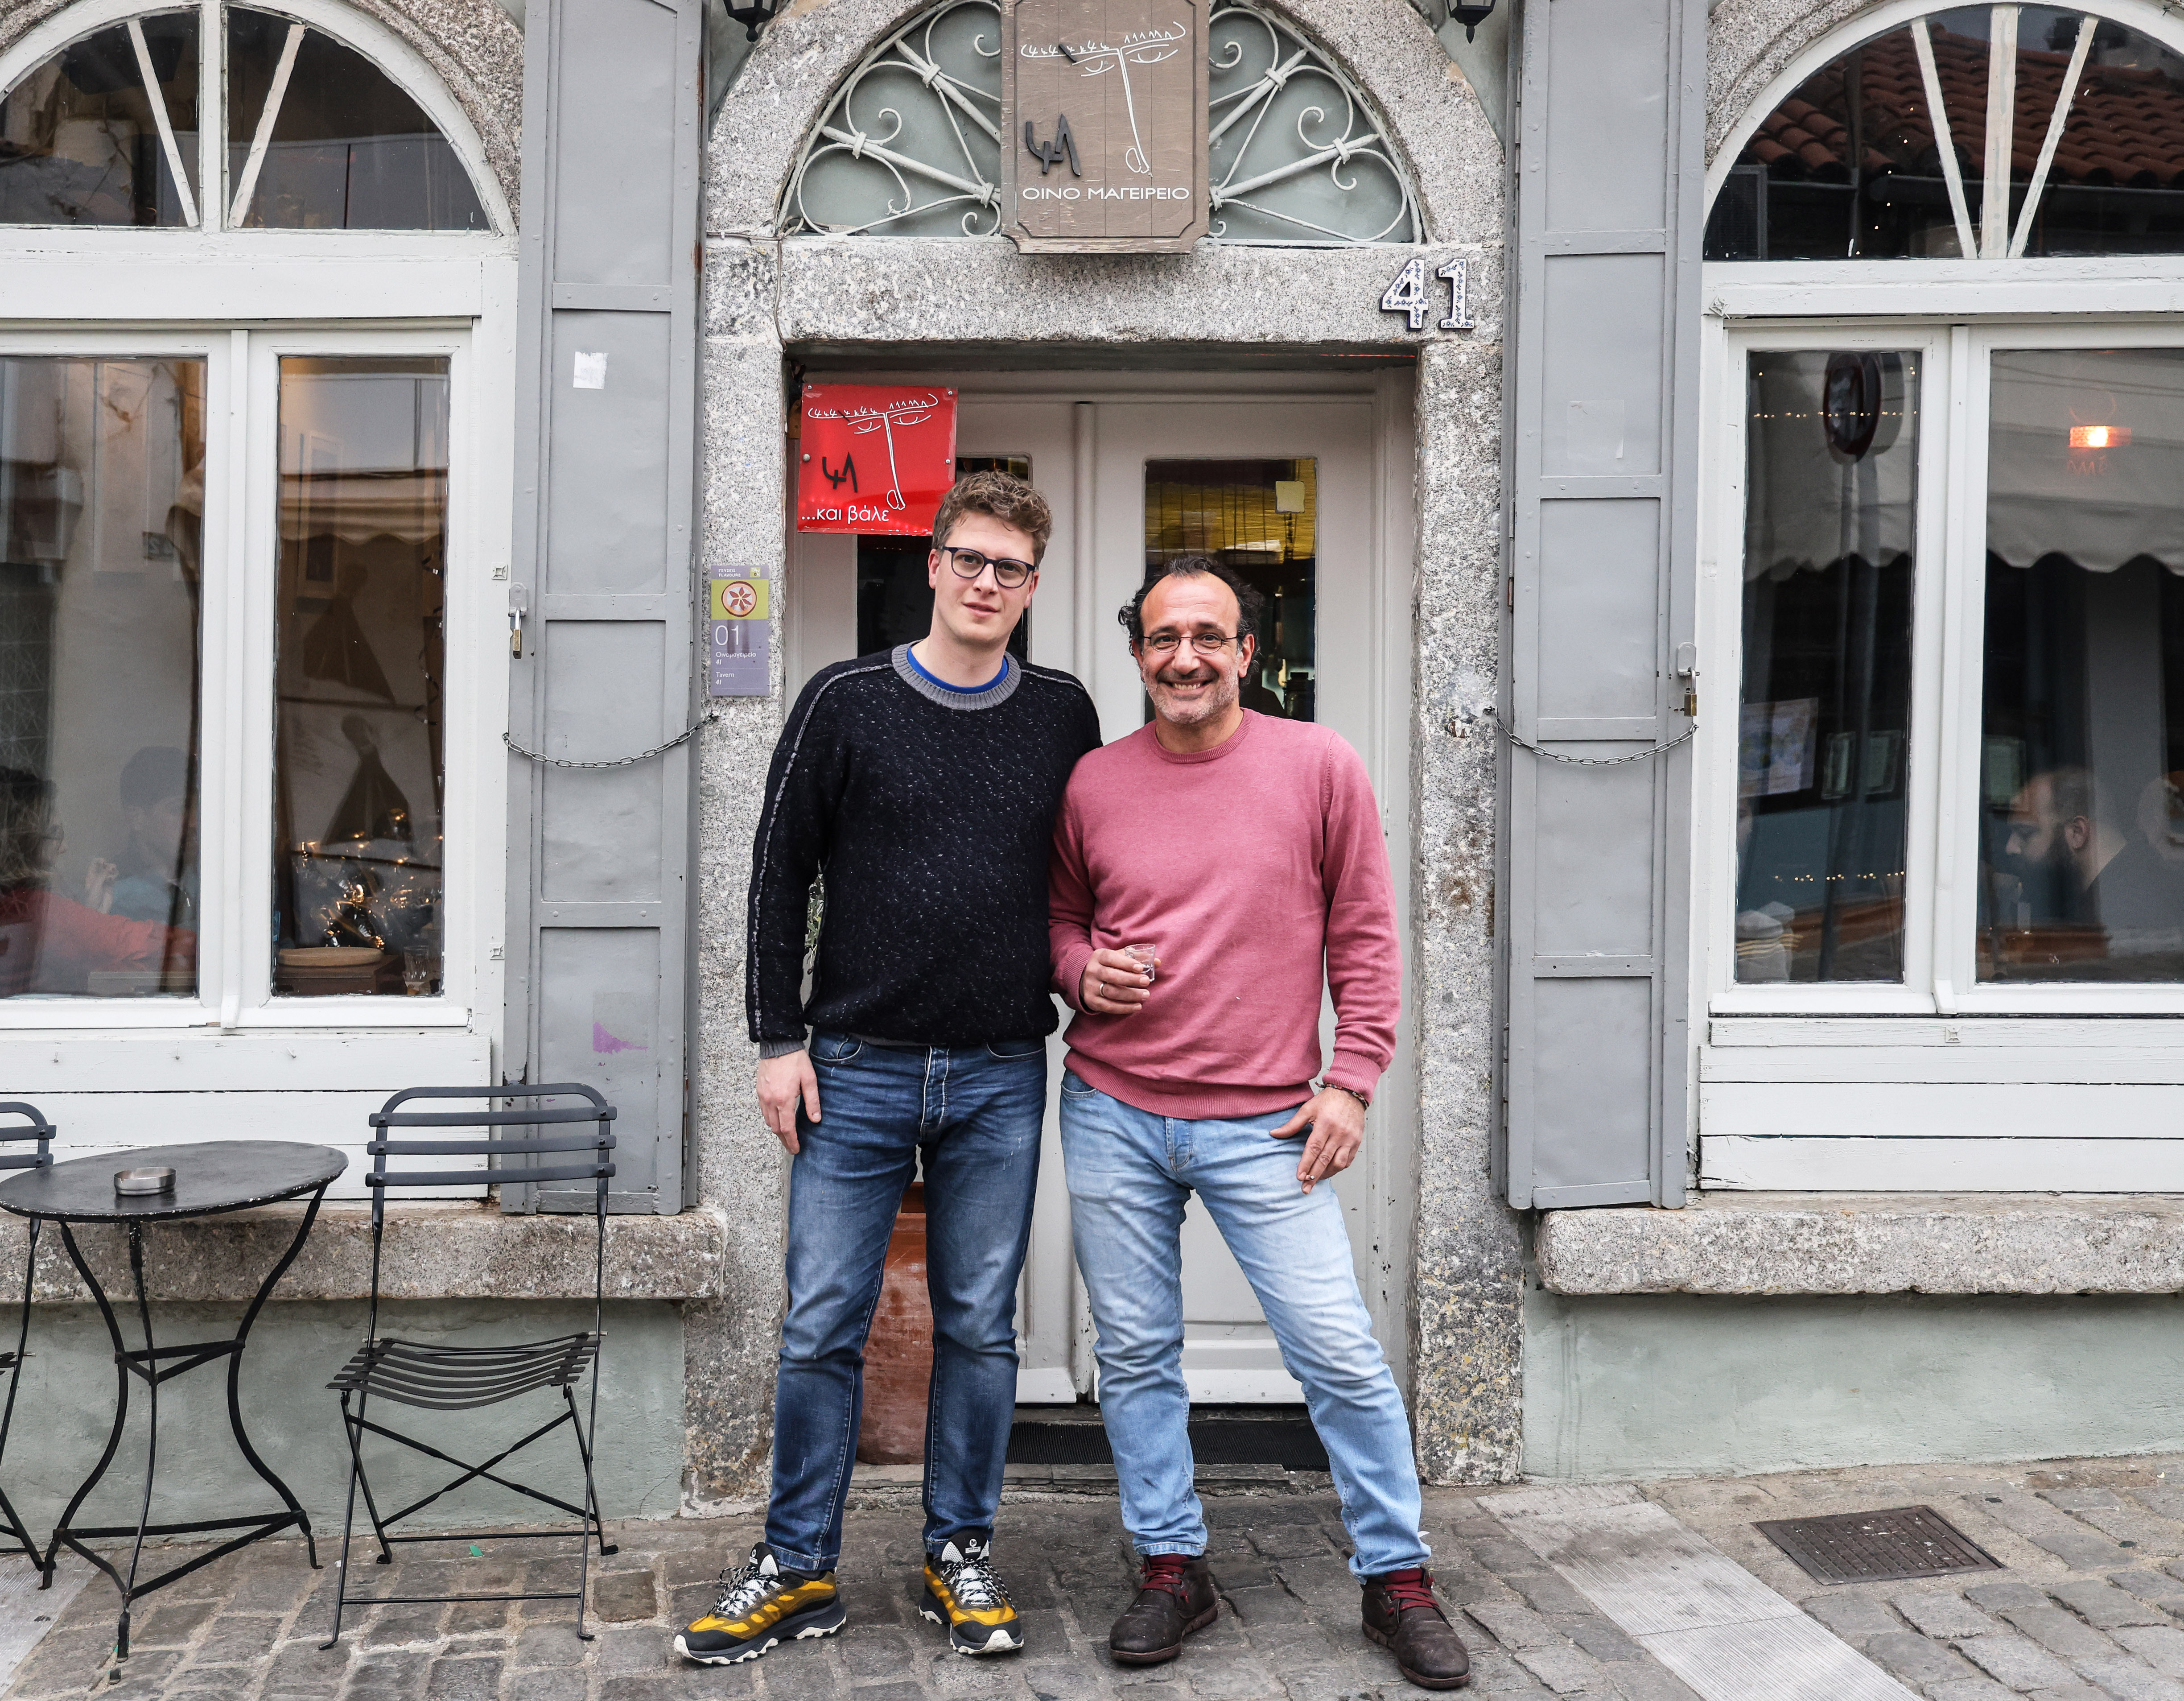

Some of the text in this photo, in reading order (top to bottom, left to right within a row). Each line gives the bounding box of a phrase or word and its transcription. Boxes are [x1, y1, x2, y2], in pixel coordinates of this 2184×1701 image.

[1022, 187, 1190, 200] ΟΙΝΟ ΜΑΓΕΙΡΕΙΟ
[1380, 259, 1475, 330] 41
[848, 504, 890, 524] βάλε
[715, 625, 739, 645] 01
